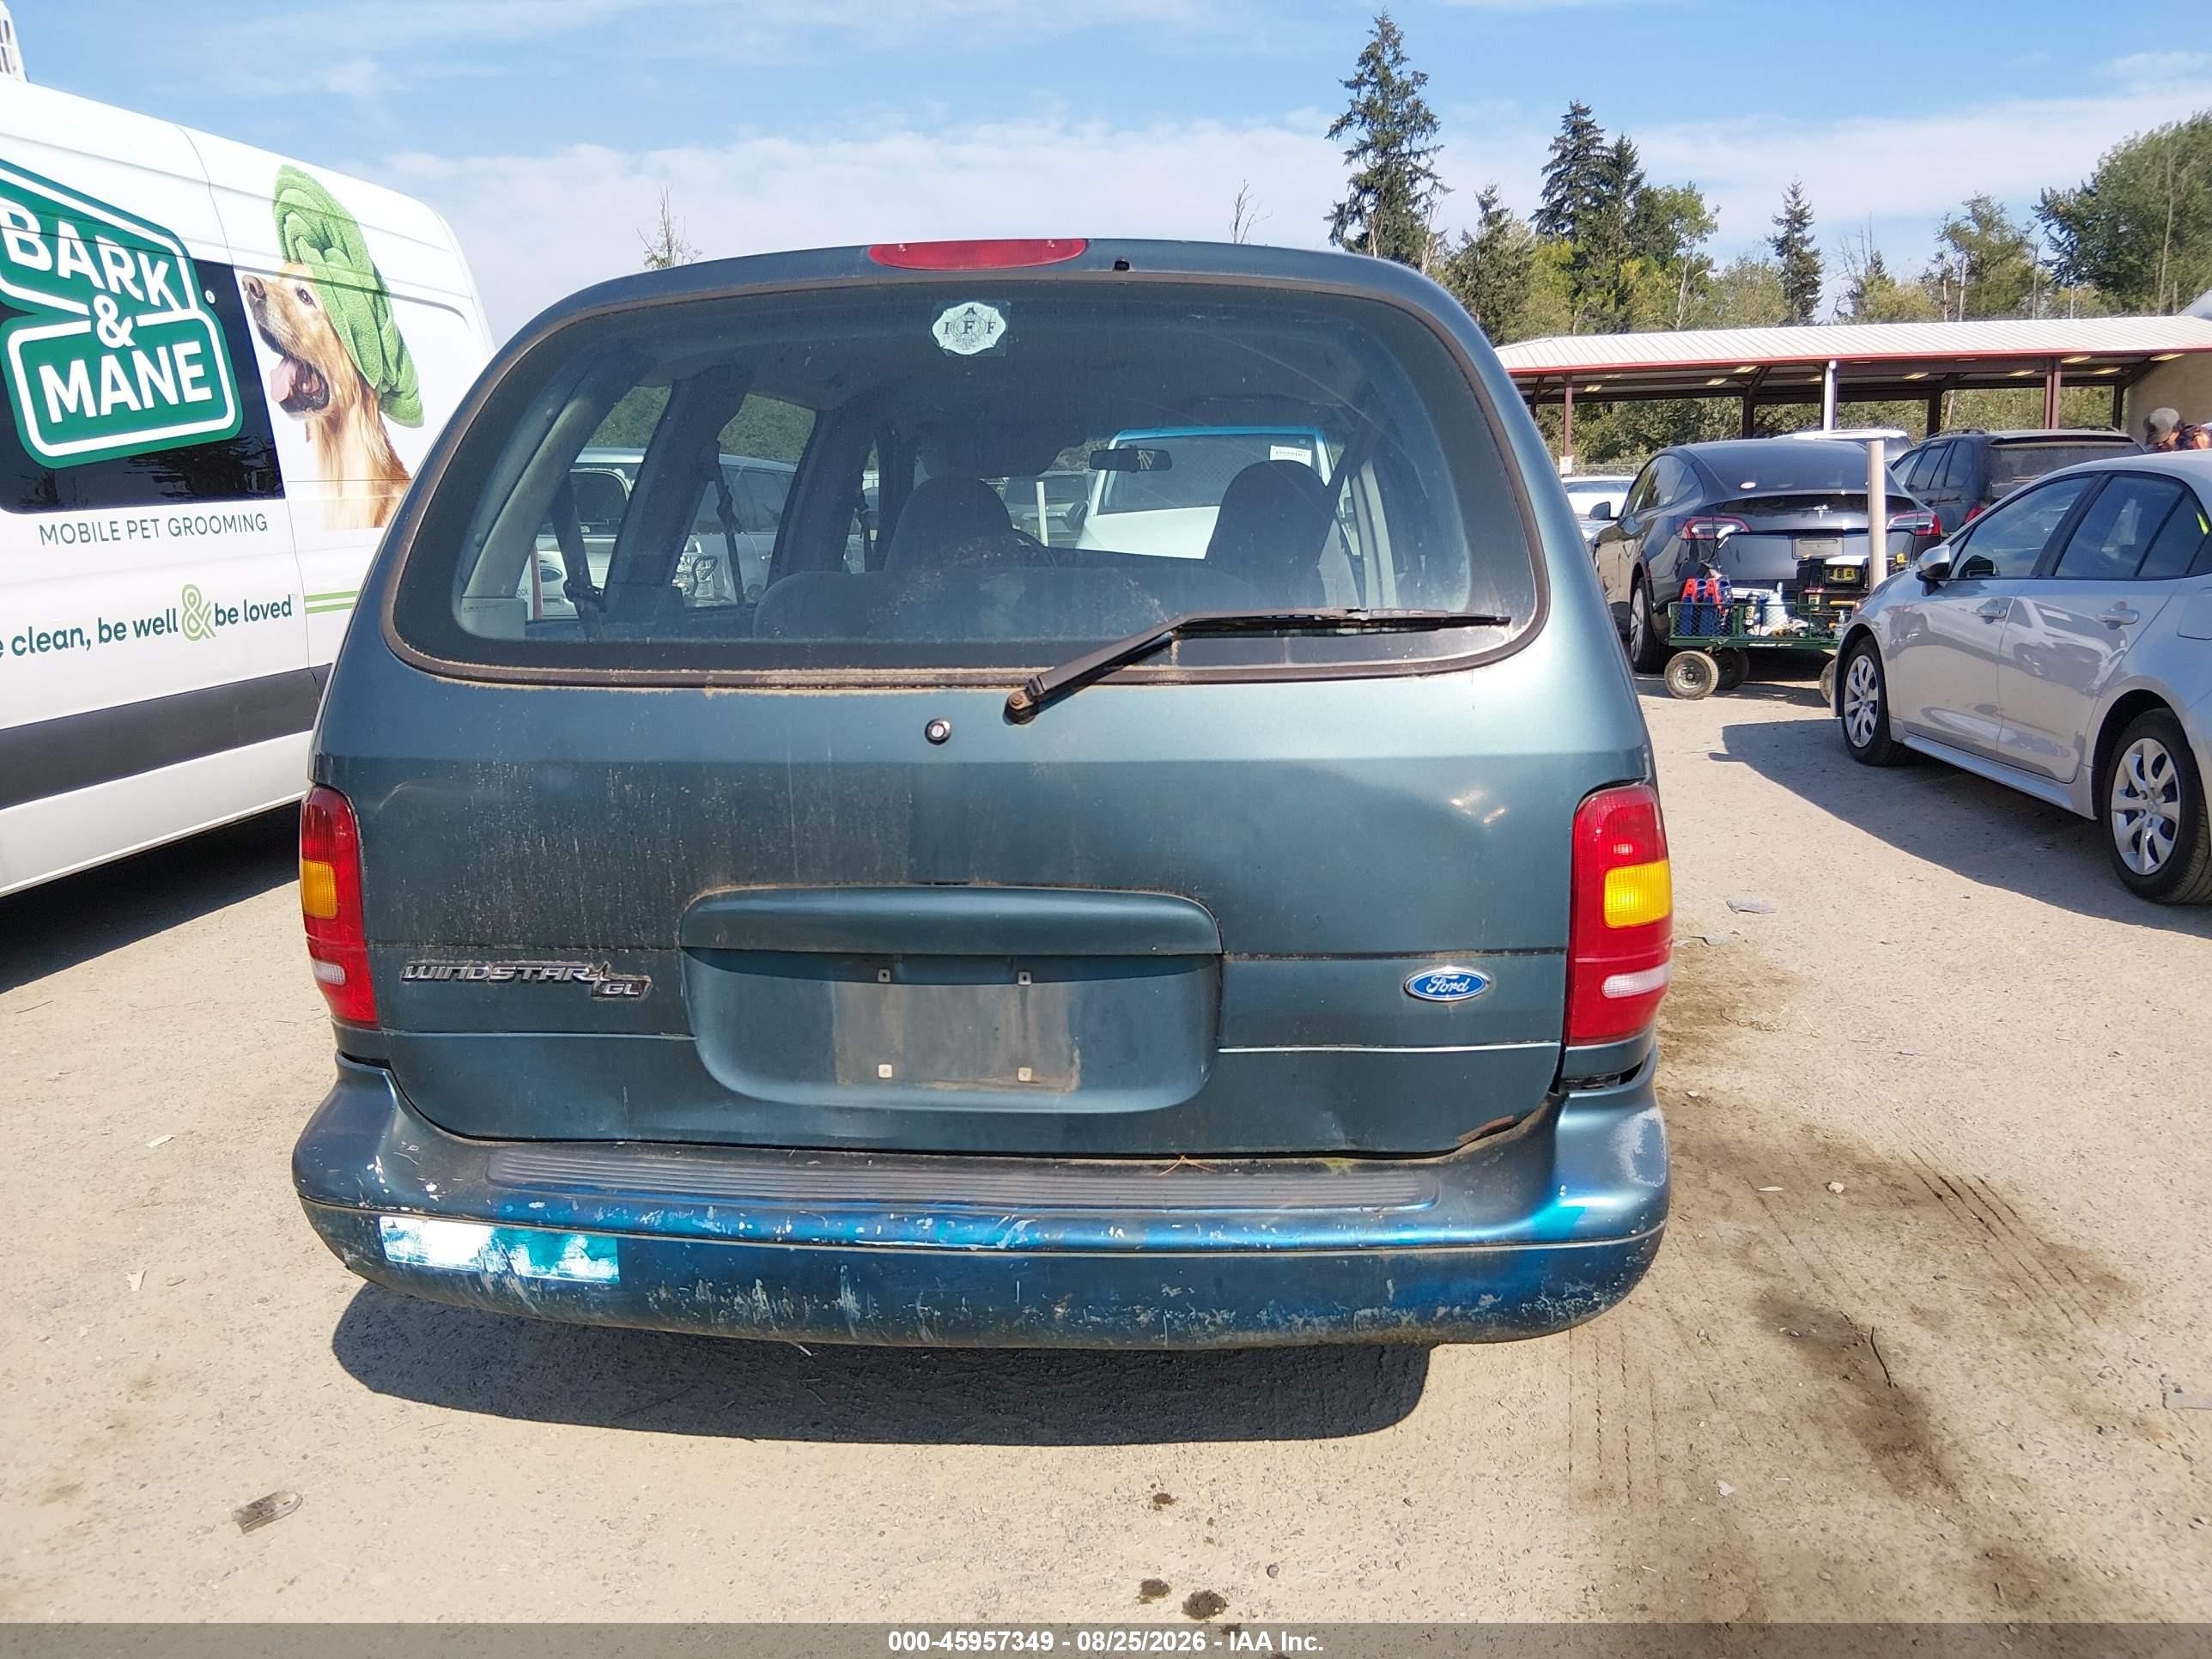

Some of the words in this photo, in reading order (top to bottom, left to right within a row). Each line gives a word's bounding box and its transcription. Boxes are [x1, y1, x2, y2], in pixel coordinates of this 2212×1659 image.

[0, 197, 180, 311] BARK
[93, 295, 136, 348] &
[39, 341, 212, 423] MANE
[39, 520, 121, 546] MOBILE
[126, 519, 160, 540] PET
[167, 513, 268, 537] GROOMING
[11, 626, 92, 657] clean,
[98, 617, 127, 644] be
[132, 608, 179, 639] well
[181, 584, 216, 641] &
[215, 603, 239, 627] be
[244, 594, 293, 622] loved
[403, 964, 611, 983] WINDSTAR
[601, 983, 640, 996] GL
[1425, 975, 1471, 994] Ford
